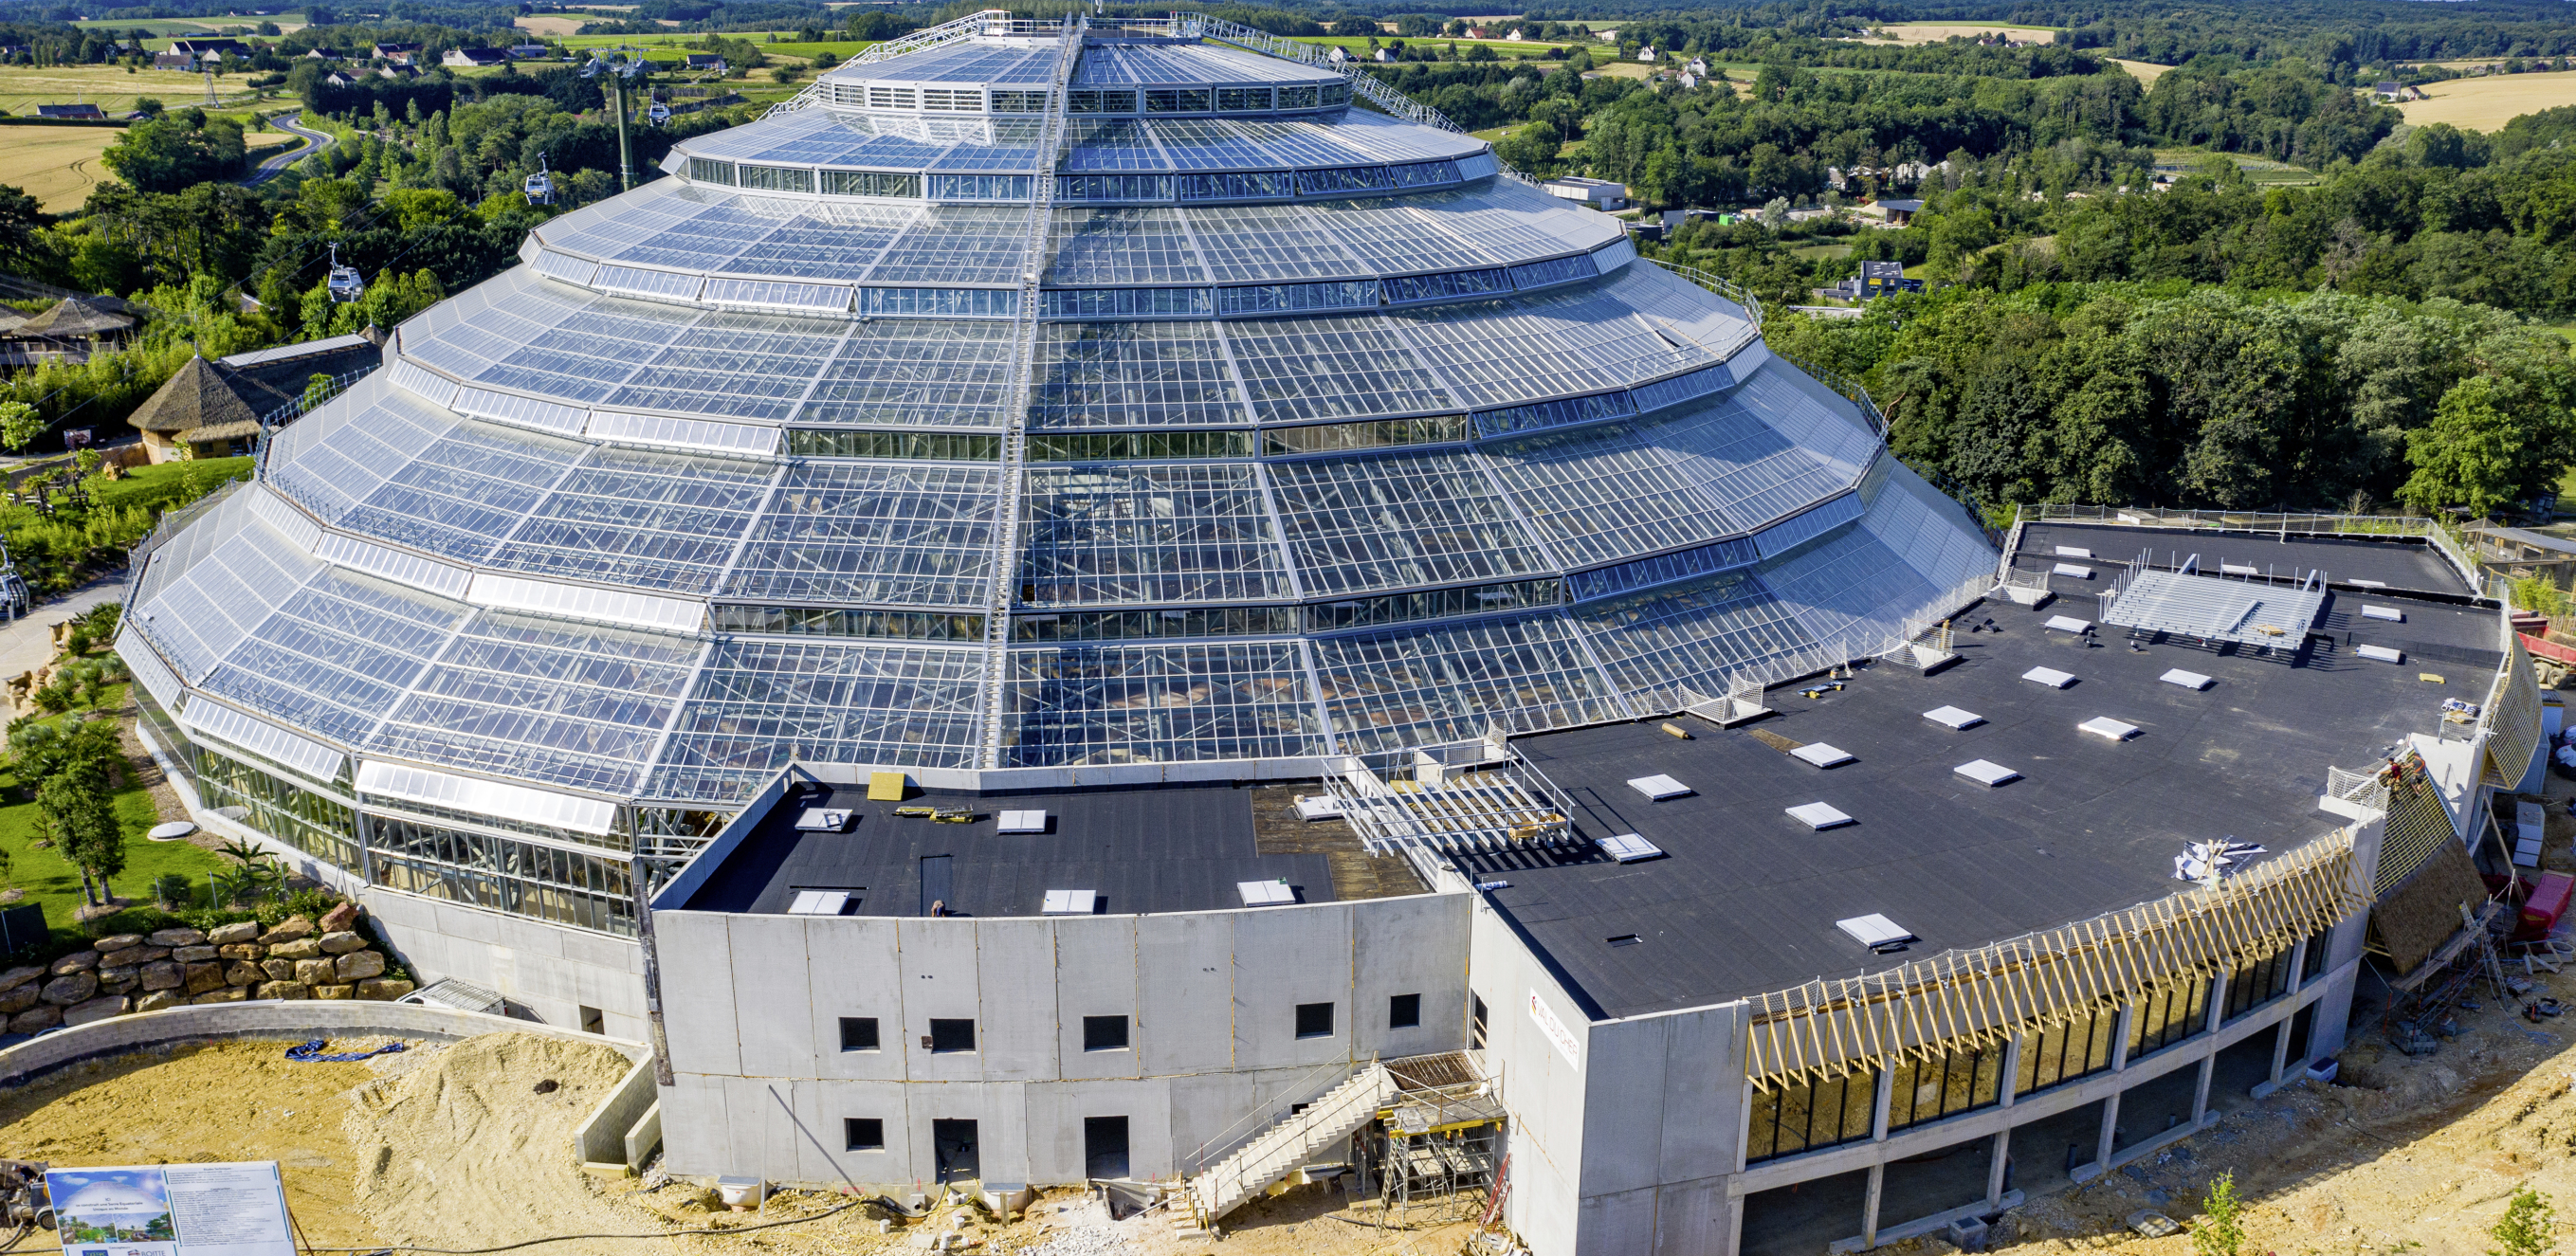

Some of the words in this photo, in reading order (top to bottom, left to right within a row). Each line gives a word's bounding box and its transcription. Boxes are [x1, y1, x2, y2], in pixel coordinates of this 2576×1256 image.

[1538, 1002, 1548, 1026] VAL
[1549, 1016, 1560, 1037] DU
[1560, 1029, 1578, 1060] CHER
